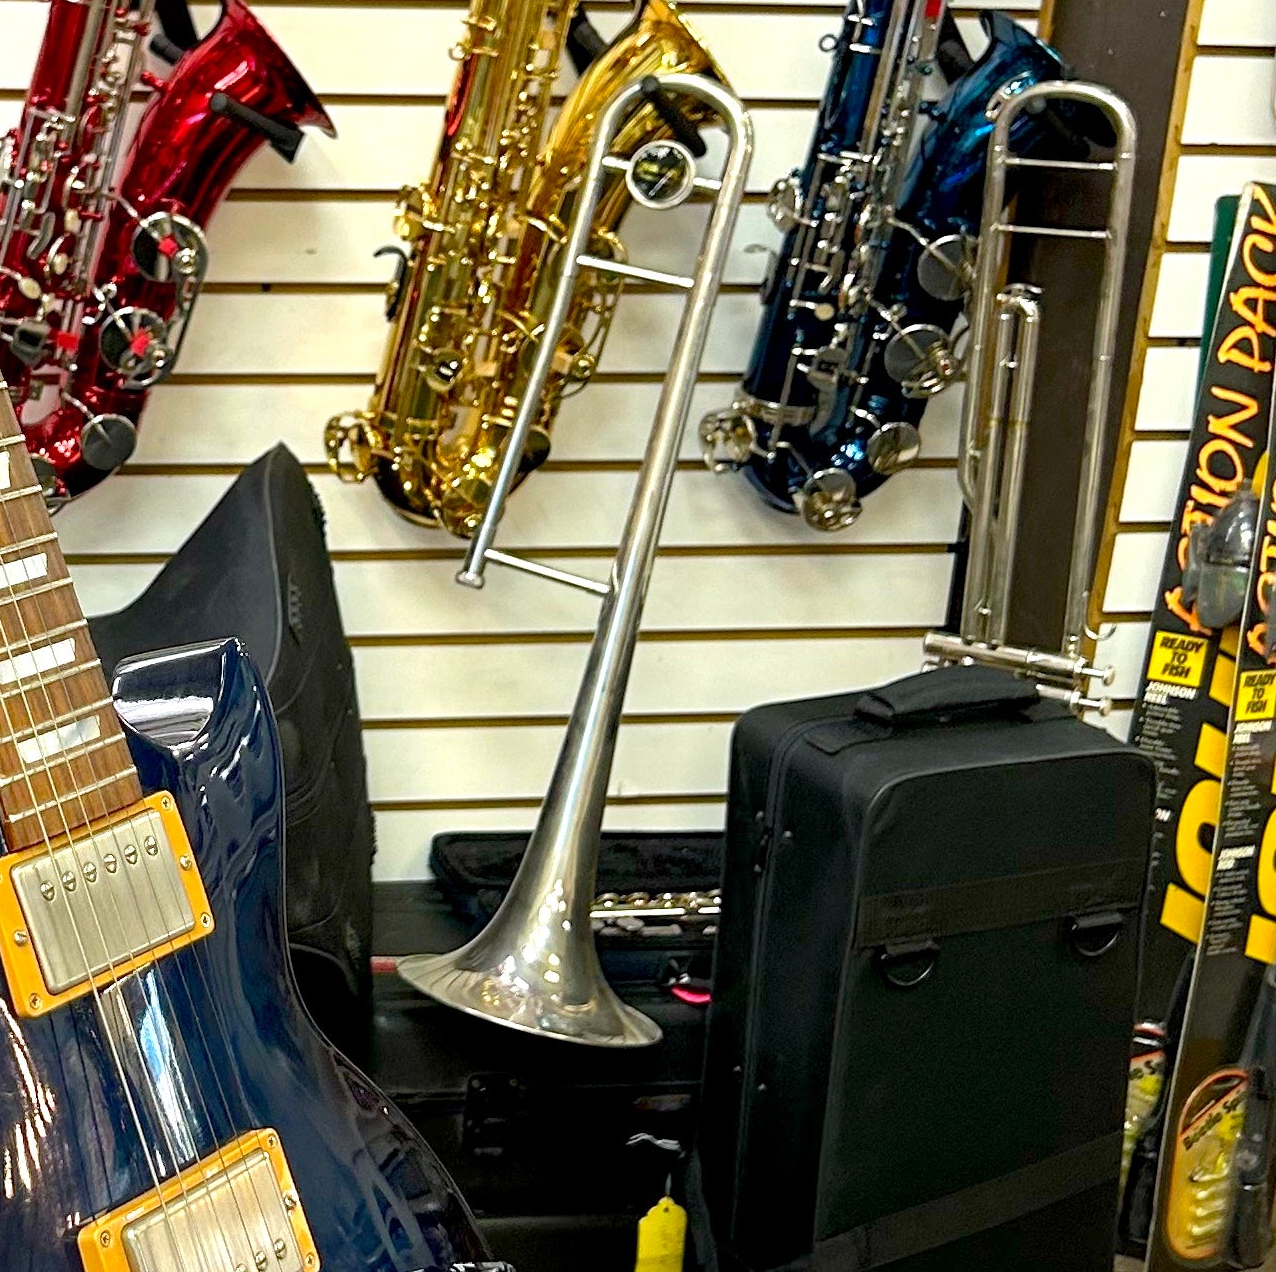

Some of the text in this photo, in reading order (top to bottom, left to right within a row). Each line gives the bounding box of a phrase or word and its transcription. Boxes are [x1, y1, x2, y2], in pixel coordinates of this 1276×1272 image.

[1159, 636, 1204, 653] READY
[1171, 651, 1188, 665] TO
[1161, 663, 1192, 678] FISH
[1243, 672, 1276, 688] READY
[1145, 681, 1197, 700] JOHNSON
[1252, 687, 1265, 698] TO
[1245, 699, 1267, 714] FISH
